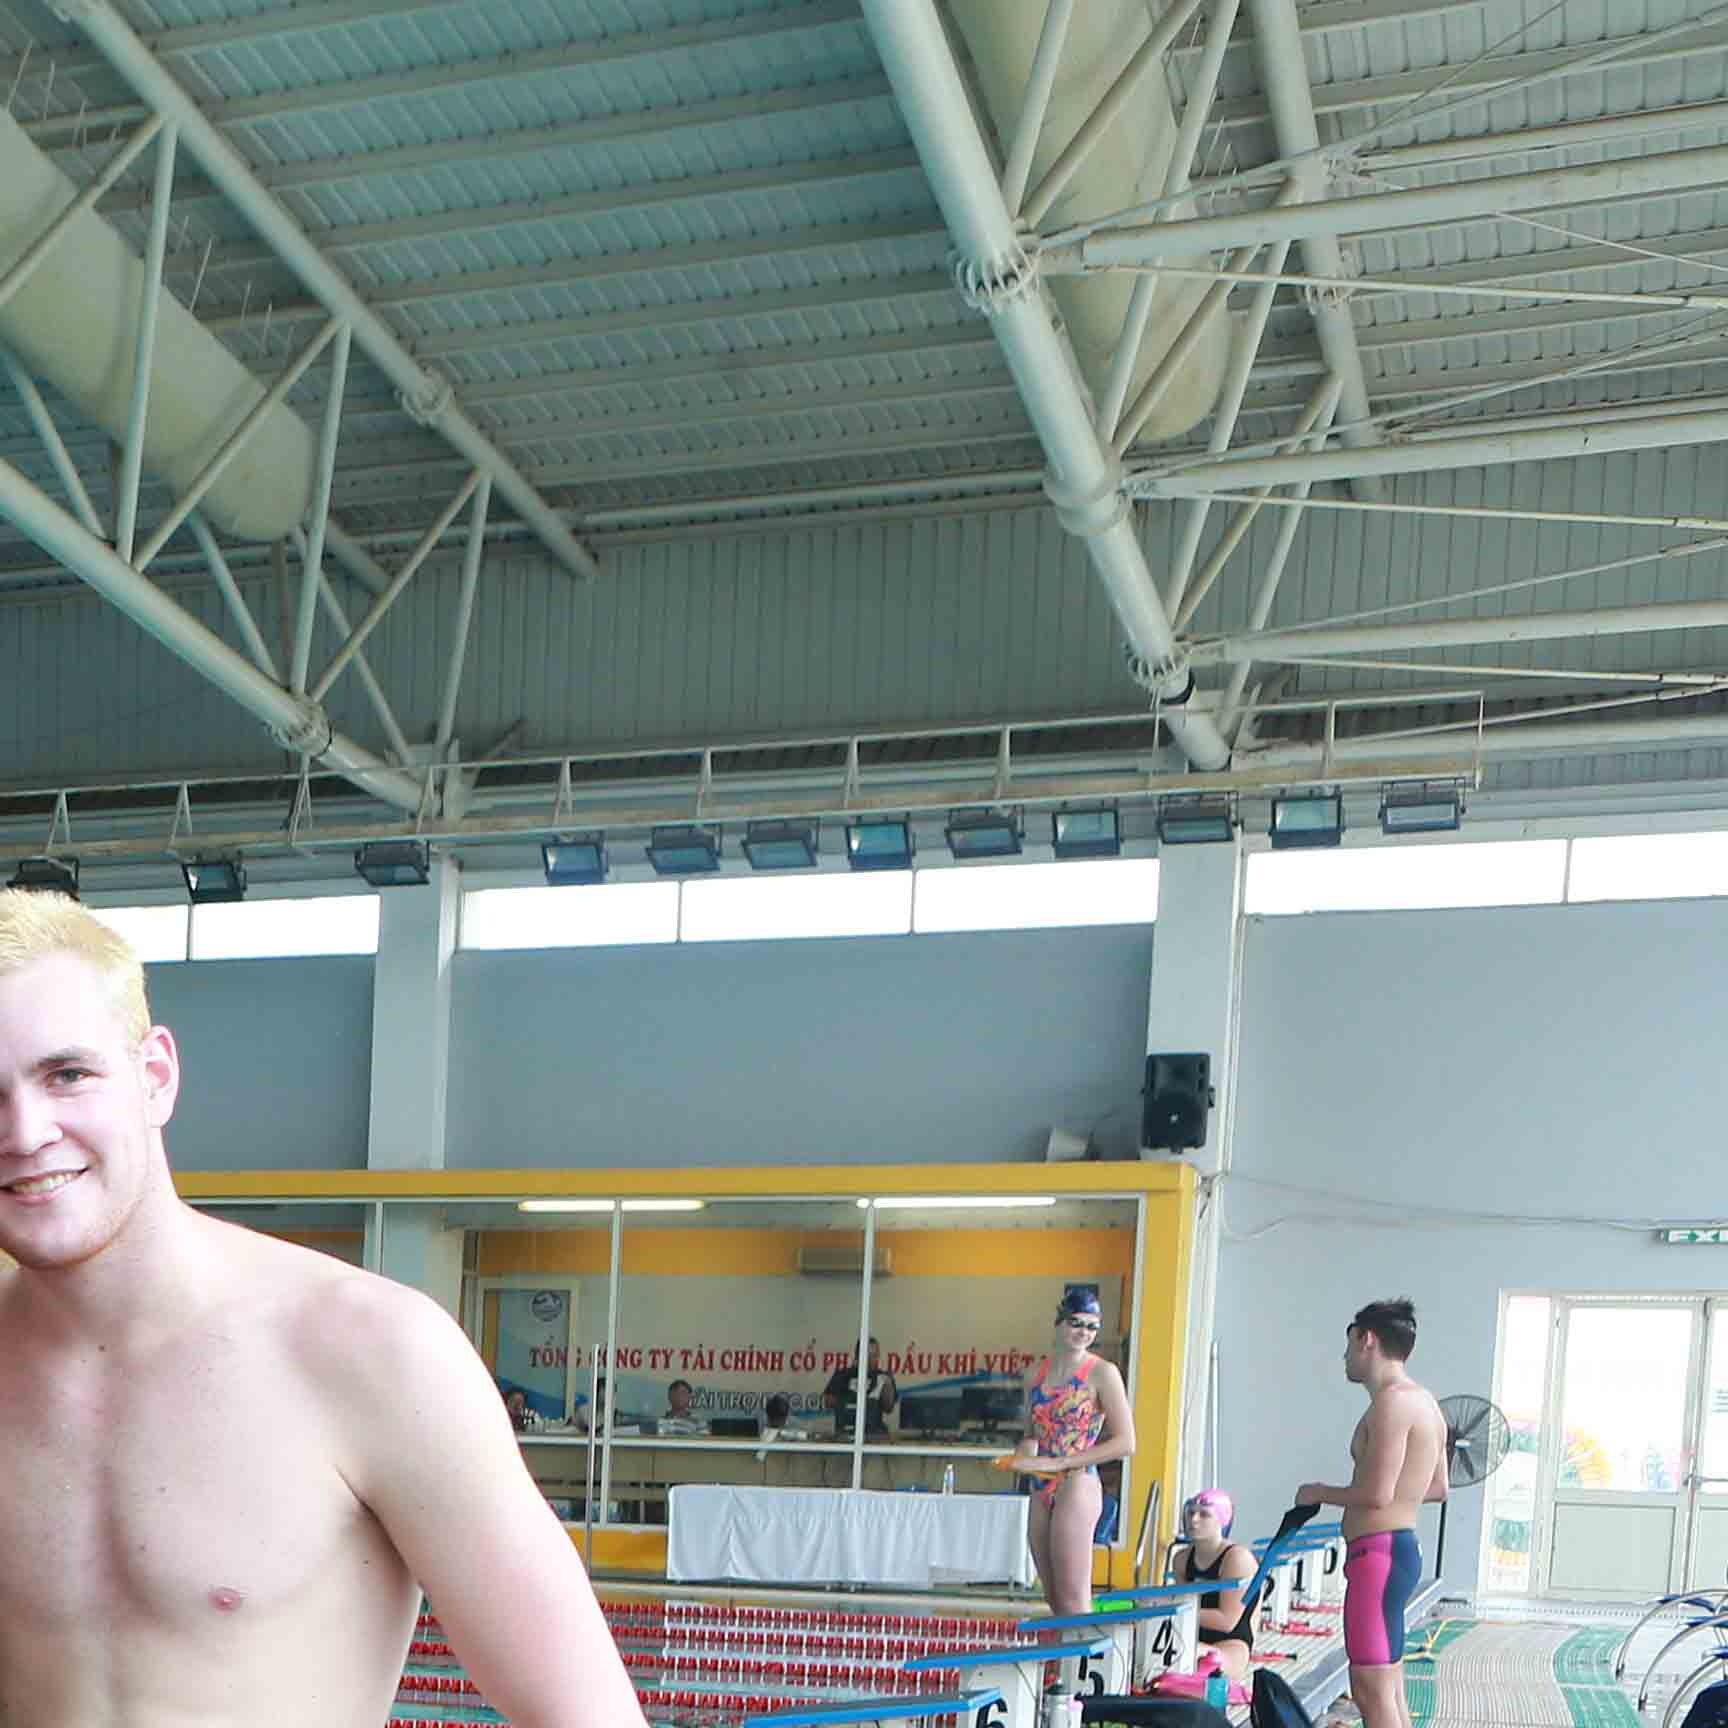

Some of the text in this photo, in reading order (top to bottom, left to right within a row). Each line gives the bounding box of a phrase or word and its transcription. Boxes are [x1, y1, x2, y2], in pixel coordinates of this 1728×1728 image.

[648, 1348, 674, 1369] TY
[1292, 1559, 1305, 1592] 1
[1152, 1616, 1177, 1666] 4
[1078, 1654, 1104, 1697] 5
